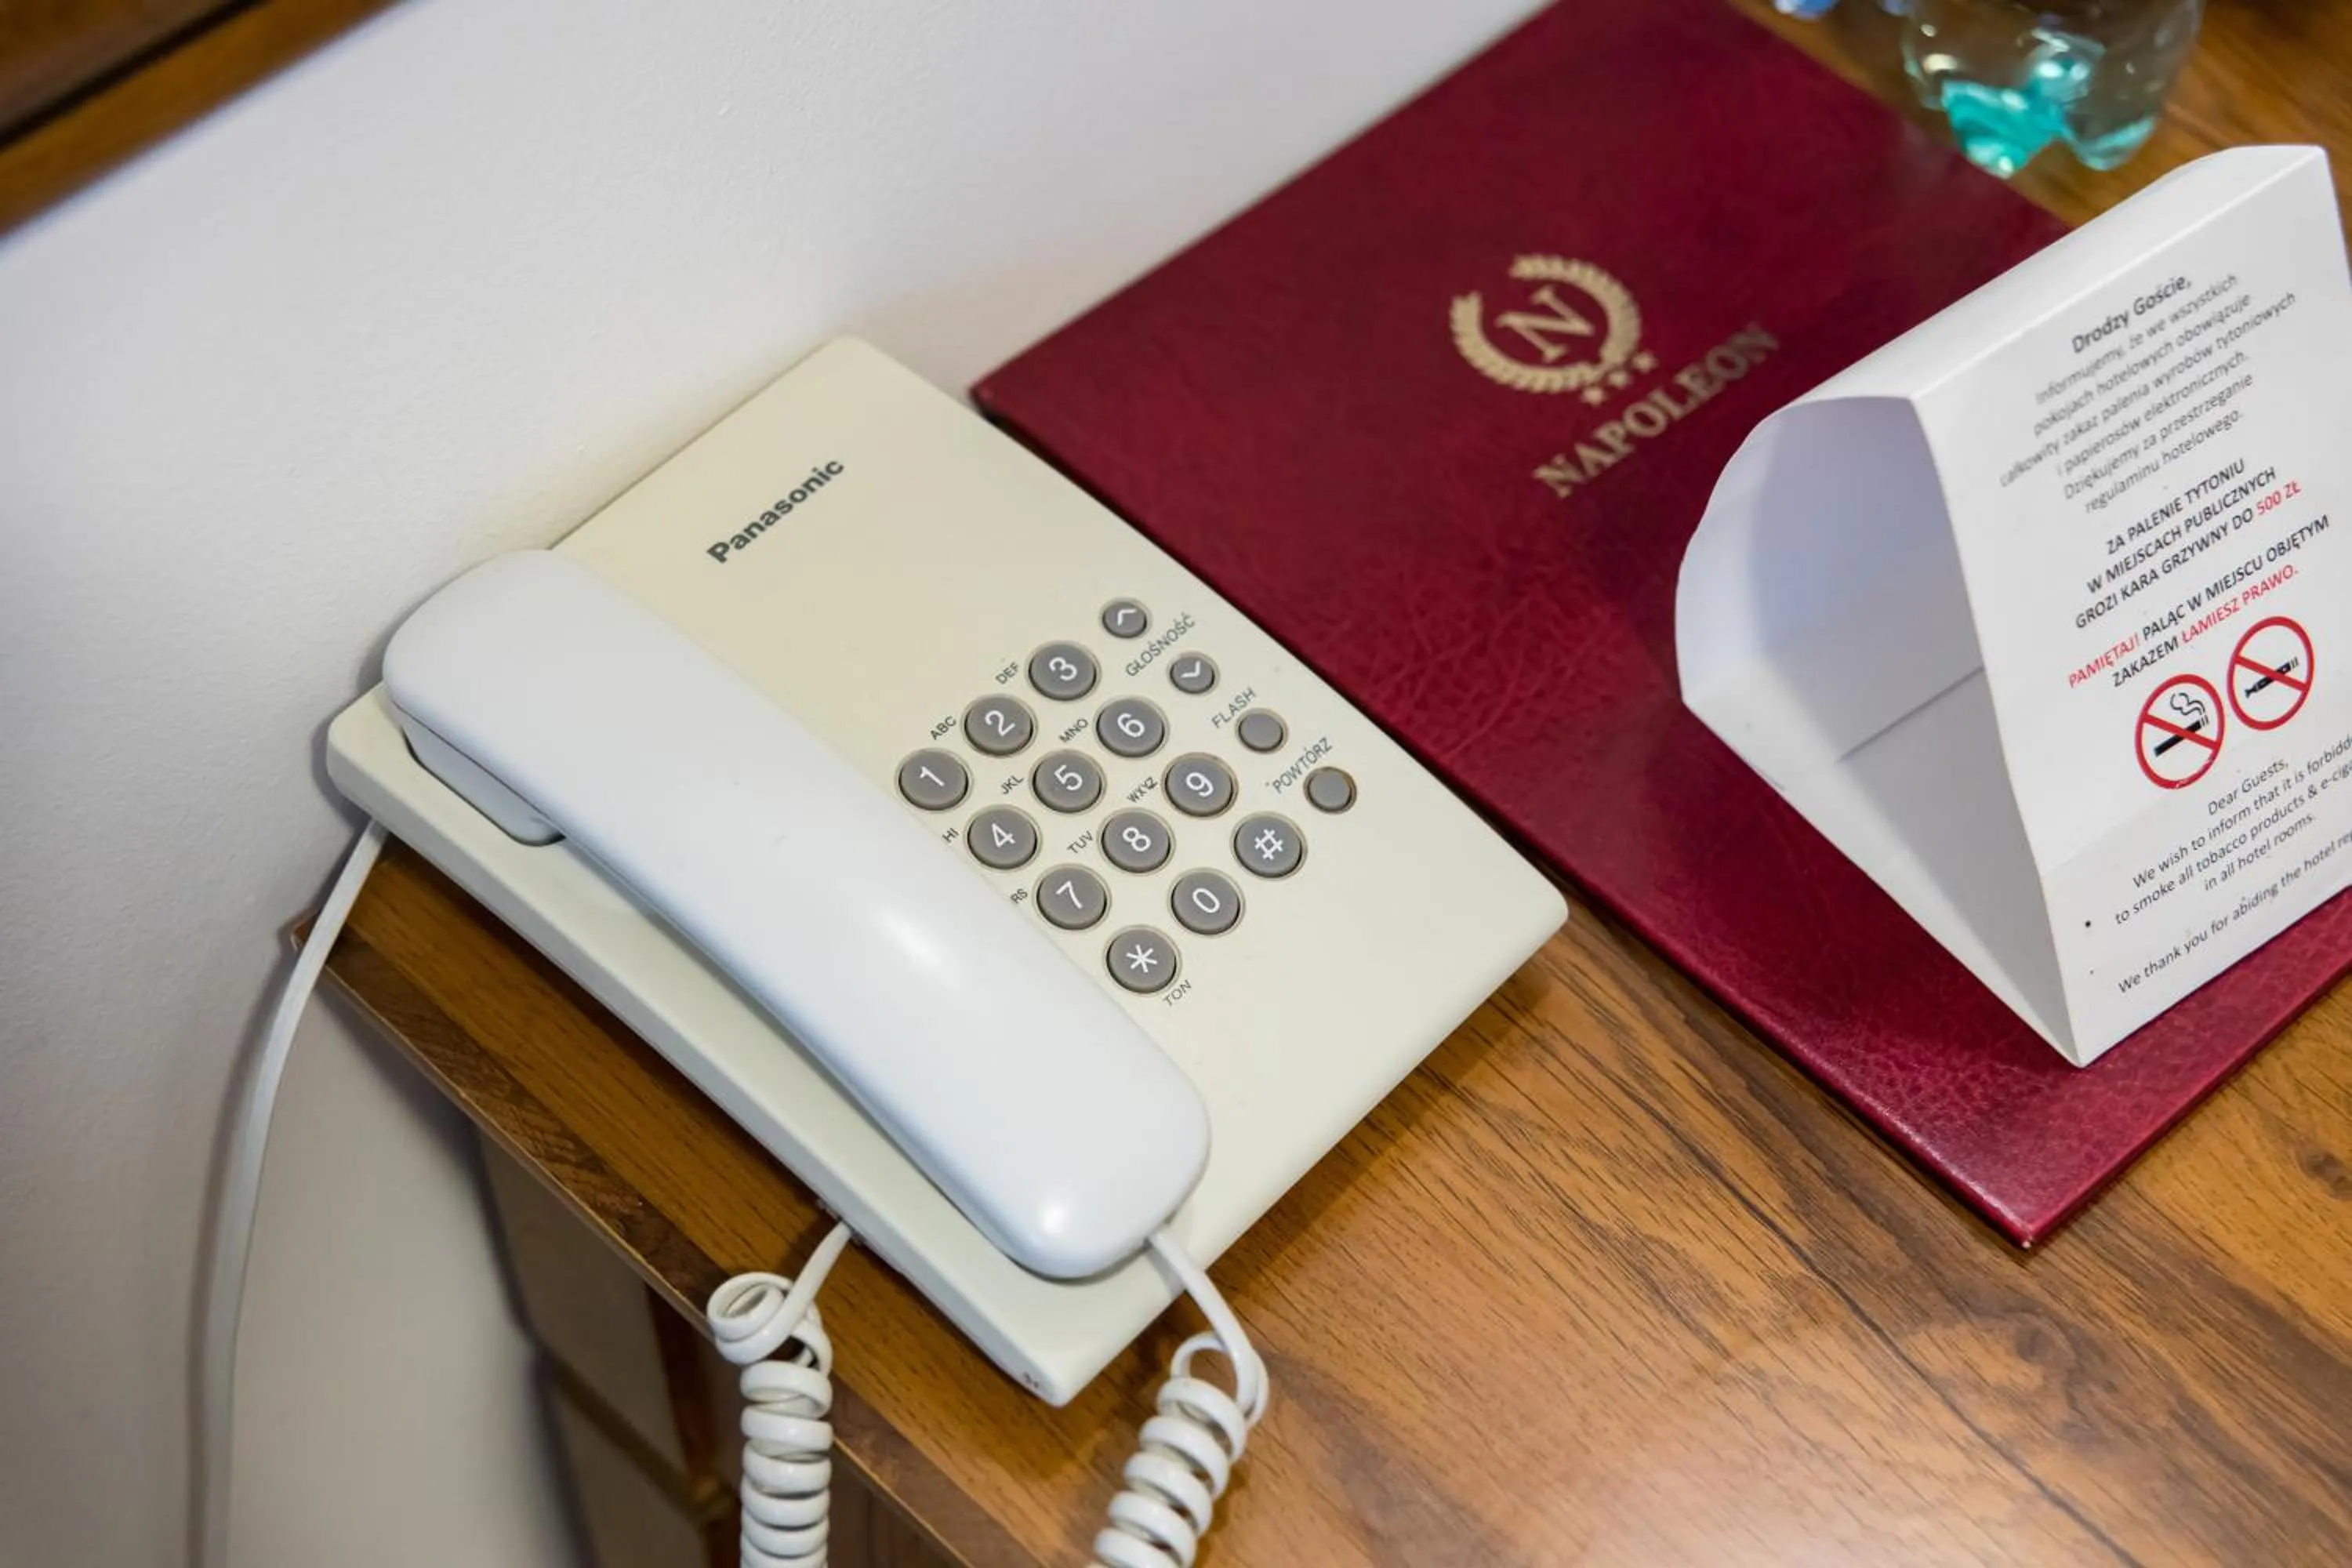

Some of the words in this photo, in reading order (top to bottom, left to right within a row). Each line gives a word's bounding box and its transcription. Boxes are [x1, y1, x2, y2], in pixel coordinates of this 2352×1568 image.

[1494, 285, 1595, 364] N
[2072, 309, 2129, 353] Drodzy
[2133, 276, 2192, 315] Goście,
[2146, 319, 2166, 337] we
[2169, 274, 2237, 324] wszystkich
[2034, 389, 2094, 439] pokojach
[2096, 341, 2173, 394] hotelowych
[2176, 294, 2250, 347] obowiązuje
[2063, 416, 2098, 445] zakaz
[2101, 383, 2150, 423] palenia
[2152, 344, 2213, 388] wyrobów
[2216, 291, 2296, 350] tytoniowych
[1532, 322, 1779, 499] NAPOLEON
[2063, 445, 2140, 500] Dziękujemy
[2142, 434, 2157, 451] za
[2159, 373, 2252, 441] przestrzeganie
[2063, 416, 2140, 474] papierosów
[2084, 459, 2160, 514] regulaminu
[2161, 410, 2244, 464] hotelowego.
[706, 460, 844, 564] Panasonic
[2086, 574, 2103, 593] W
[2105, 526, 2182, 583] MIEJSCACH
[2183, 466, 2276, 533] PUBLICZNYCH
[2107, 535, 2125, 555] ZA
[2127, 496, 2183, 541] PALENIE
[2184, 458, 2245, 504] TYTONIU
[2075, 593, 2118, 629] GROZI
[2120, 568, 2160, 601] KARA
[2161, 522, 2228, 574] GRZYWNY
[2232, 508, 2253, 530] DO
[2256, 491, 2281, 516] 500
[2283, 480, 2302, 499] ZŁ
[2068, 633, 2140, 688] PAMIĘTAJ!
[2143, 604, 2186, 641] PALĄC
[2187, 592, 2202, 612] W
[2205, 555, 2263, 601] MIEJSCU
[2267, 514, 2329, 562] OBJĘTYM
[2111, 636, 2179, 688] ZAKAZEM
[2181, 597, 2240, 643] ŁAMIESZ
[2242, 564, 2299, 604] PRAWO.
[1049, 657, 1077, 681] 3
[1125, 612, 1196, 677] GŁOŚNOŚĆ
[995, 662, 1020, 684] DEF
[930, 716, 956, 740] ABC
[985, 710, 1016, 736] 2
[1058, 718, 1089, 742] MNO
[1117, 713, 1145, 737] 6
[1211, 687, 1256, 728] FLASH
[920, 766, 946, 786] 1
[1000, 775, 1025, 794] JKL
[1054, 764, 1083, 790] 5
[1127, 777, 1158, 803] WXYZ
[1185, 772, 1214, 797] 9
[1272, 737, 1333, 793] POWTÓRZ
[2208, 789, 2238, 816] Dear
[2241, 759, 2288, 793] Guests,
[942, 827, 960, 843] HI
[992, 823, 1016, 848] 4
[1067, 829, 1094, 854] TUV
[1123, 827, 1151, 852] 8
[1254, 829, 1283, 860] #
[2115, 909, 2130, 925] to
[2132, 880, 2175, 914] smoke
[2179, 864, 2194, 885] all
[2196, 833, 2247, 873] tobacco
[2249, 795, 2305, 841] products
[2307, 784, 2318, 800] &
[2132, 867, 2155, 888] We
[2158, 845, 2188, 873] wish
[2191, 836, 2205, 850] to
[2208, 806, 2251, 840] inform
[2253, 786, 2281, 810] that
[2282, 779, 2292, 792] it
[2294, 771, 2305, 784] is
[2204, 877, 2217, 891] in
[2220, 862, 2235, 882] all
[2237, 838, 2271, 870] hotel
[1011, 888, 1028, 904] RS
[1056, 880, 1083, 909] 7
[1192, 887, 1220, 913] 0
[2118, 974, 2141, 993] We
[2144, 946, 2182, 978] thank
[2183, 931, 2209, 954] you
[2210, 915, 2229, 935] for
[2233, 884, 2278, 920] abiding
[2281, 866, 2302, 887] the
[2303, 840, 2336, 872] hotel
[1163, 979, 1192, 1007] TON
